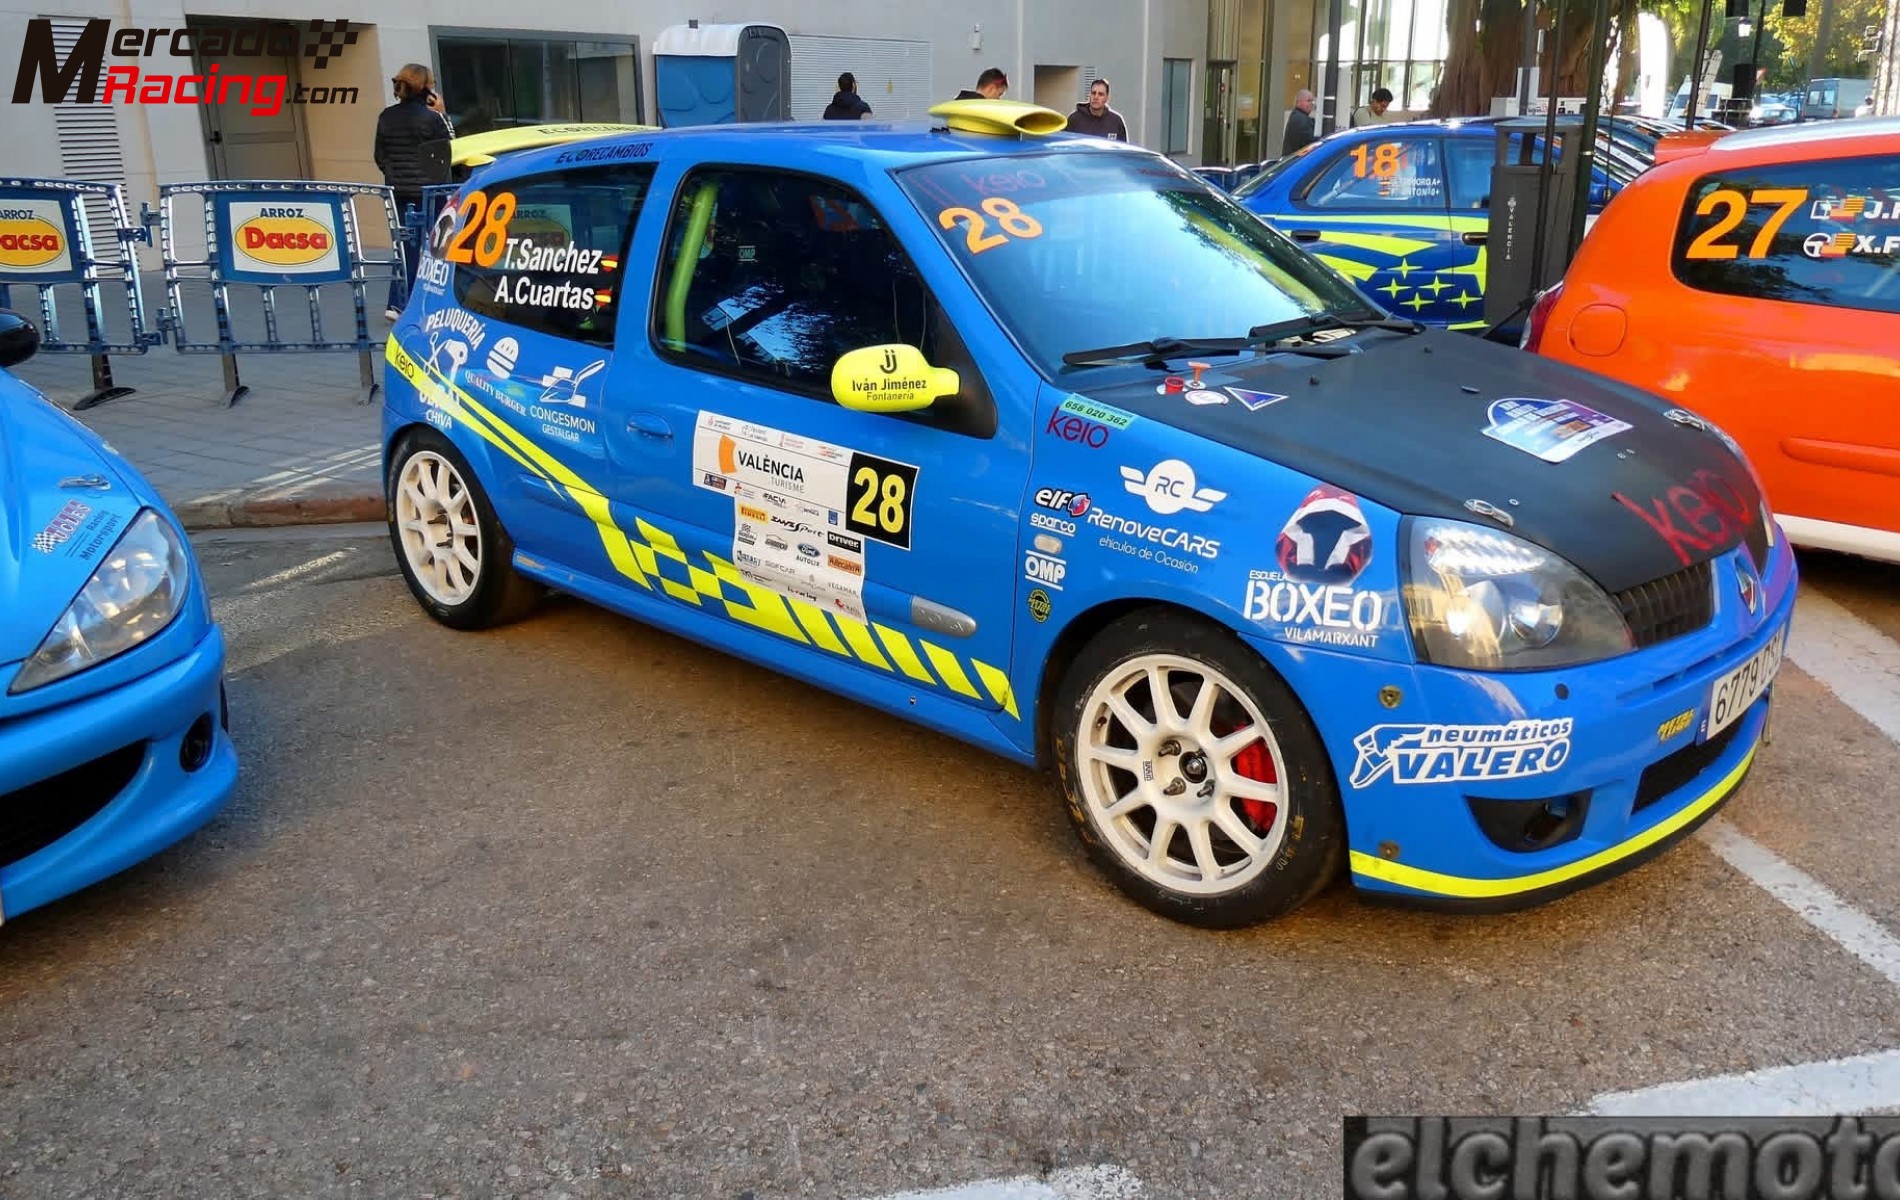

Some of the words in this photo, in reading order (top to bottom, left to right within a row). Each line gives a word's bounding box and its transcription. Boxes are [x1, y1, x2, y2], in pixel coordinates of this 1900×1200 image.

[1350, 144, 1400, 178] 18
[260, 208, 304, 218] ARROZ
[938, 197, 1043, 254] 28
[1685, 189, 1808, 259] 27
[0, 234, 59, 251] acsa
[244, 227, 328, 250] Dacsa
[446, 190, 517, 267] 28
[504, 238, 603, 275] T.Sanchez
[494, 275, 594, 310] A.Cuartas
[852, 377, 877, 392] Iván
[881, 376, 927, 391] Jiménez
[495, 389, 527, 417] BURGER
[1086, 408, 1106, 419] 020
[426, 409, 452, 429] CHIVA
[530, 405, 596, 434] CONGESMON
[738, 450, 804, 483] VALÈNCIA
[852, 467, 906, 534] 28
[1035, 488, 1072, 510] elf
[1154, 475, 1185, 498] RC
[1030, 512, 1076, 533] sparco
[1138, 546, 1153, 560] de
[1025, 556, 1065, 584] OMP
[1243, 580, 1382, 632] BOXEO
[1285, 627, 1379, 648] VILAMARXANT
[1715, 656, 1759, 725] 6779
[1427, 721, 1570, 742] neumáticos
[1397, 740, 1570, 780] VALERO
